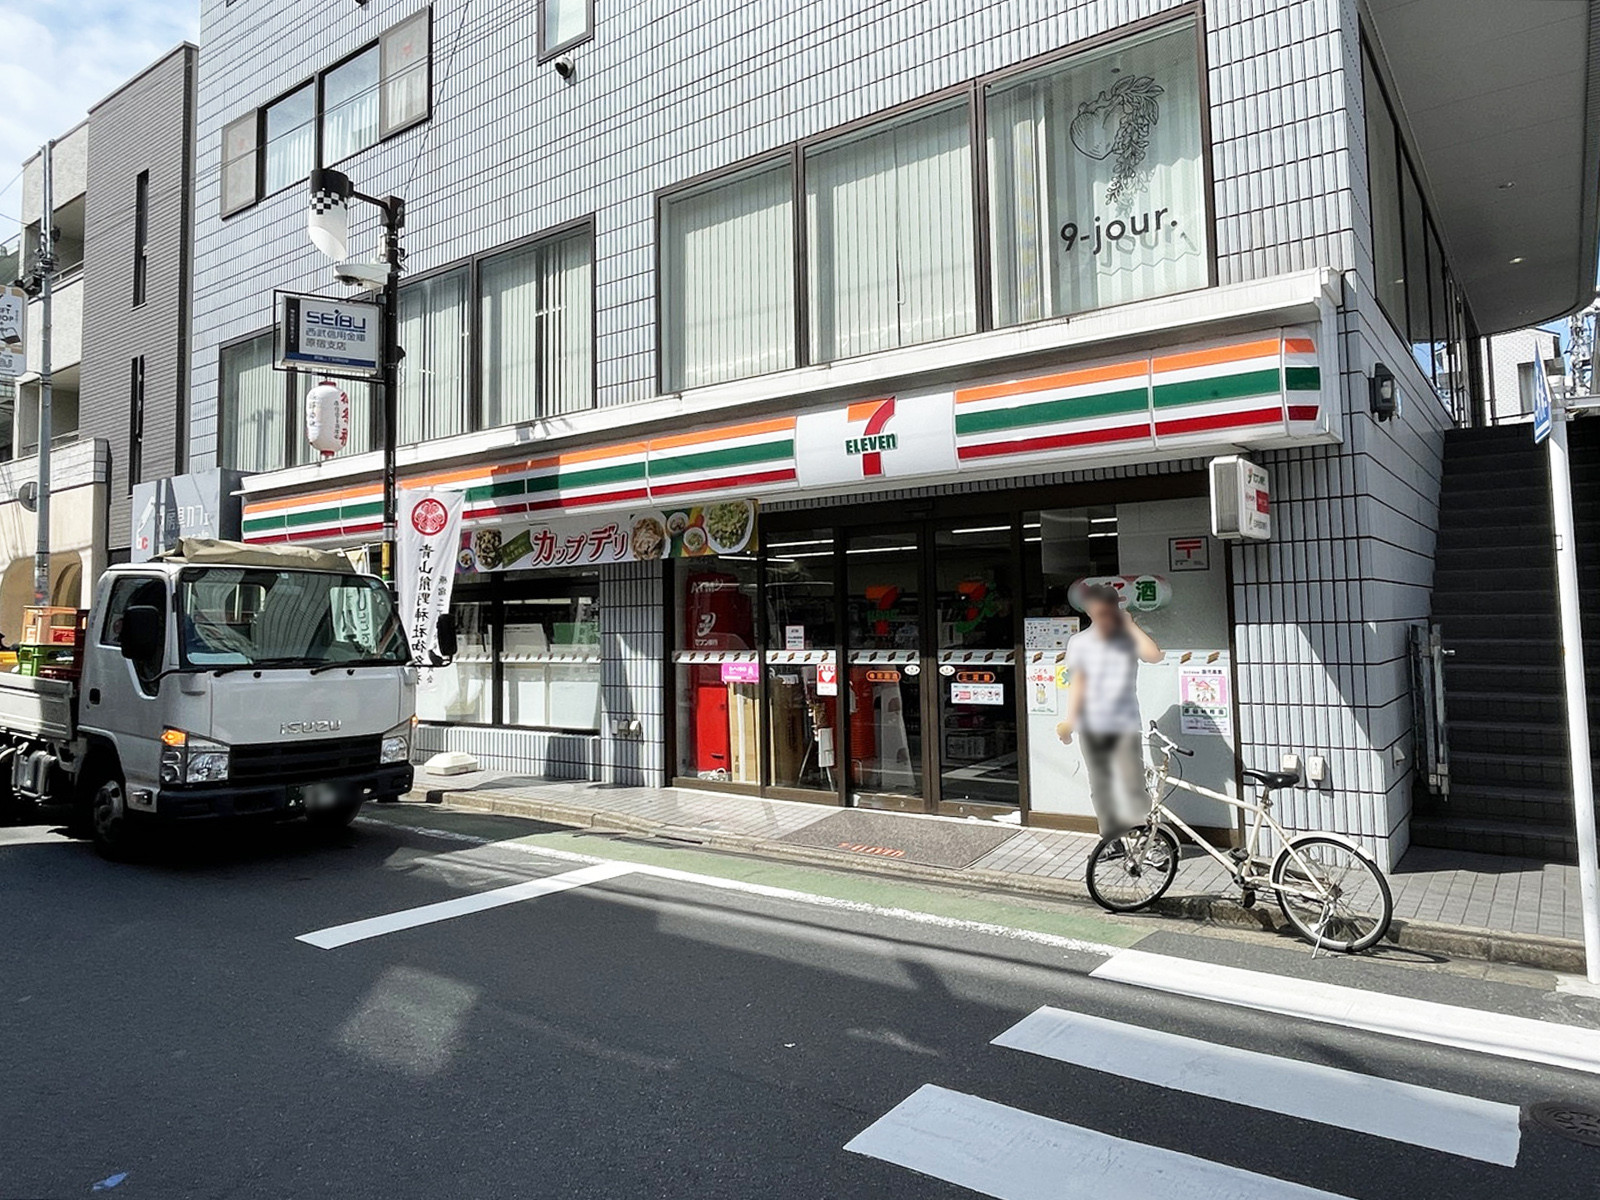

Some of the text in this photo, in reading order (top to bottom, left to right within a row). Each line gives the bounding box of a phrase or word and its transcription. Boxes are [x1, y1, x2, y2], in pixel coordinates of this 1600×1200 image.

[1061, 207, 1178, 255] 9-jour.
[306, 309, 366, 330] SEIBU
[305, 327, 366, 342] 西武信用金庫
[305, 337, 347, 351] 原宿支店
[846, 395, 896, 476] 7
[531, 522, 629, 568] カップデリ
[1136, 580, 1157, 602] 酒
[280, 719, 342, 735] ISUZU
